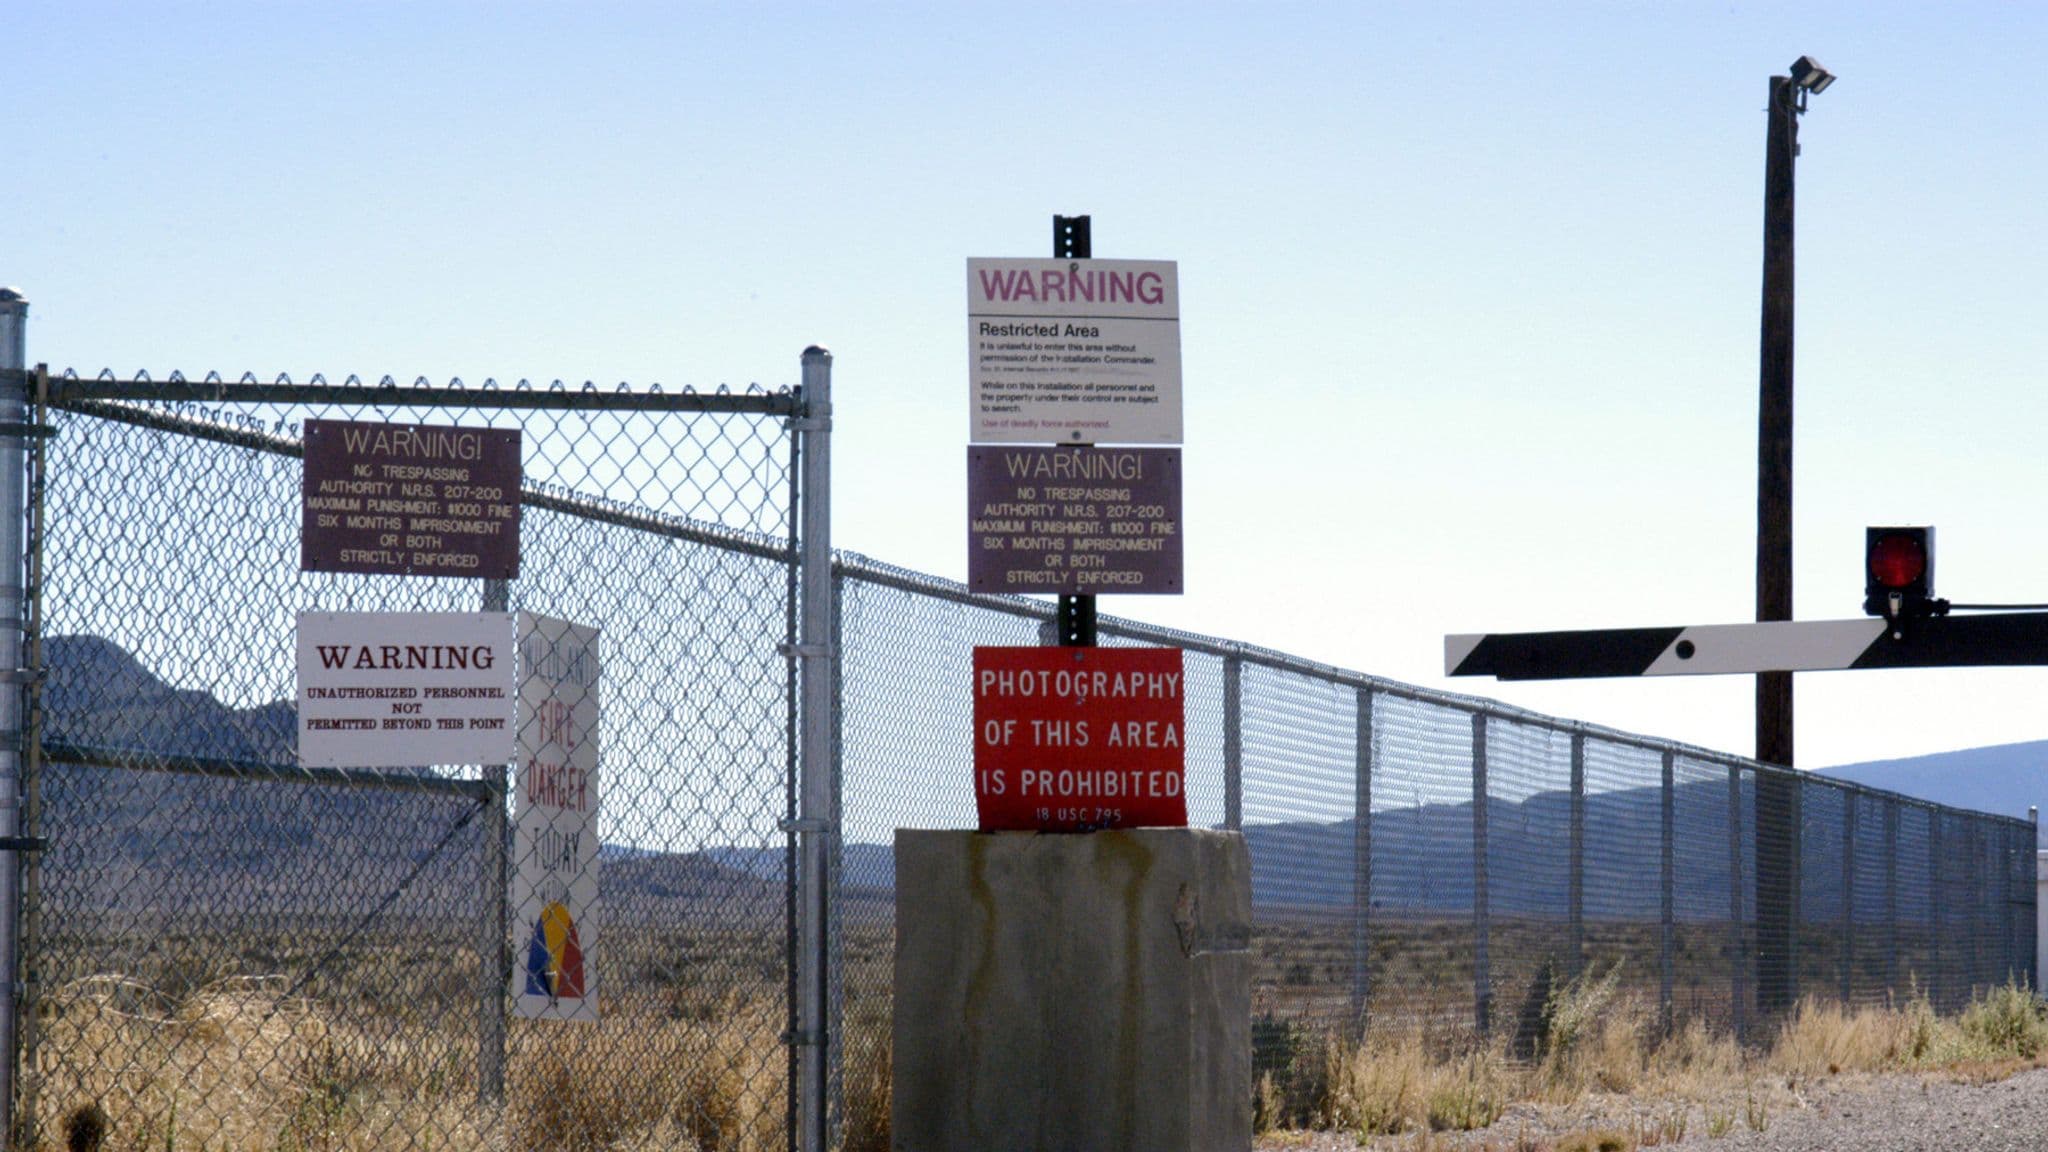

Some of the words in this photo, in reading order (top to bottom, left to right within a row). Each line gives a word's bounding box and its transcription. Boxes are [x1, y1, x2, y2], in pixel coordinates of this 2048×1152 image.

[979, 269, 1164, 304] WARNING
[979, 322, 1059, 337] Restricted
[1064, 324, 1099, 338] Area
[980, 342, 985, 350] It
[997, 342, 1032, 351] unlawful
[1034, 343, 1042, 351] to
[1068, 343, 1083, 352] this
[1105, 344, 1136, 353] without
[980, 355, 1029, 364] permission
[1041, 355, 1054, 363] the
[981, 382, 1004, 390] While
[1020, 382, 1035, 391] this
[1084, 384, 1094, 392] all
[1096, 384, 1137, 393] personnel
[1139, 385, 1155, 393] and
[981, 393, 994, 401] the
[997, 393, 1033, 403] property
[1035, 394, 1059, 402] under
[1061, 394, 1081, 403] their
[1082, 395, 1112, 403] control
[1128, 395, 1159, 405] subject
[981, 404, 990, 412] to
[982, 420, 999, 428] Use
[1000, 420, 1010, 428] of
[1011, 420, 1039, 429] deadly
[1042, 420, 1062, 428] force
[343, 428, 482, 460] WARNING!
[354, 464, 373, 477] NO
[382, 465, 469, 481] TRESPASSING
[1005, 453, 1143, 480] WARNING!
[319, 480, 394, 497] AUTHORITY
[401, 484, 436, 498] N.R.S.
[444, 486, 502, 500] 207-200
[1017, 488, 1036, 500] NO
[1044, 488, 1130, 501] TRESPASSING
[307, 497, 360, 512] MAXIMUM
[367, 500, 441, 515] PUNISHMENT:
[488, 505, 513, 518] FINE
[984, 504, 1056, 517] AUTHORITY
[1063, 505, 1099, 518] N.R.S.
[1106, 505, 1165, 518] 207-200
[318, 515, 338, 527] SIX
[347, 516, 401, 530] MONTHS
[410, 518, 502, 535] IMPRISONMENT
[973, 521, 1025, 533] MAXIMUM
[1032, 521, 1103, 534] PUNISHMENT:
[1151, 522, 1176, 535] FINE
[380, 535, 398, 547] OR
[406, 535, 442, 548] BOTH
[983, 538, 1004, 550] SIX
[1012, 538, 1065, 550] MONTHS
[1073, 538, 1165, 551] IMPRISONMENT
[340, 549, 405, 565] STRICTLY
[413, 553, 479, 568] ENFORCED
[1045, 555, 1062, 567] OR
[1070, 555, 1105, 567] BOTH
[1007, 571, 1070, 584] STRICTLY
[1077, 571, 1143, 584] ENFORCED
[316, 645, 495, 670] WARNING
[981, 669, 1179, 698] PHOTOGRAPHY
[307, 687, 417, 699] UNAUTHORIZED
[424, 688, 505, 699] PERSONNEL
[391, 703, 422, 714] NOT
[307, 718, 377, 730] PERMITTED
[382, 718, 432, 730] BEYOND
[437, 718, 464, 730] THIS
[469, 718, 505, 730] POINT
[541, 699, 576, 748] FIRE
[984, 720, 1017, 746] OF
[1031, 720, 1090, 746] THIS
[1108, 721, 1179, 748] AREA
[528, 759, 587, 812] DANGER
[982, 769, 1006, 795] IS
[1021, 769, 1180, 797] PROHIBITED
[1037, 807, 1049, 821] 18
[1057, 807, 1088, 822] USC
[1095, 808, 1122, 822] 795
[534, 827, 580, 873] TODAY
